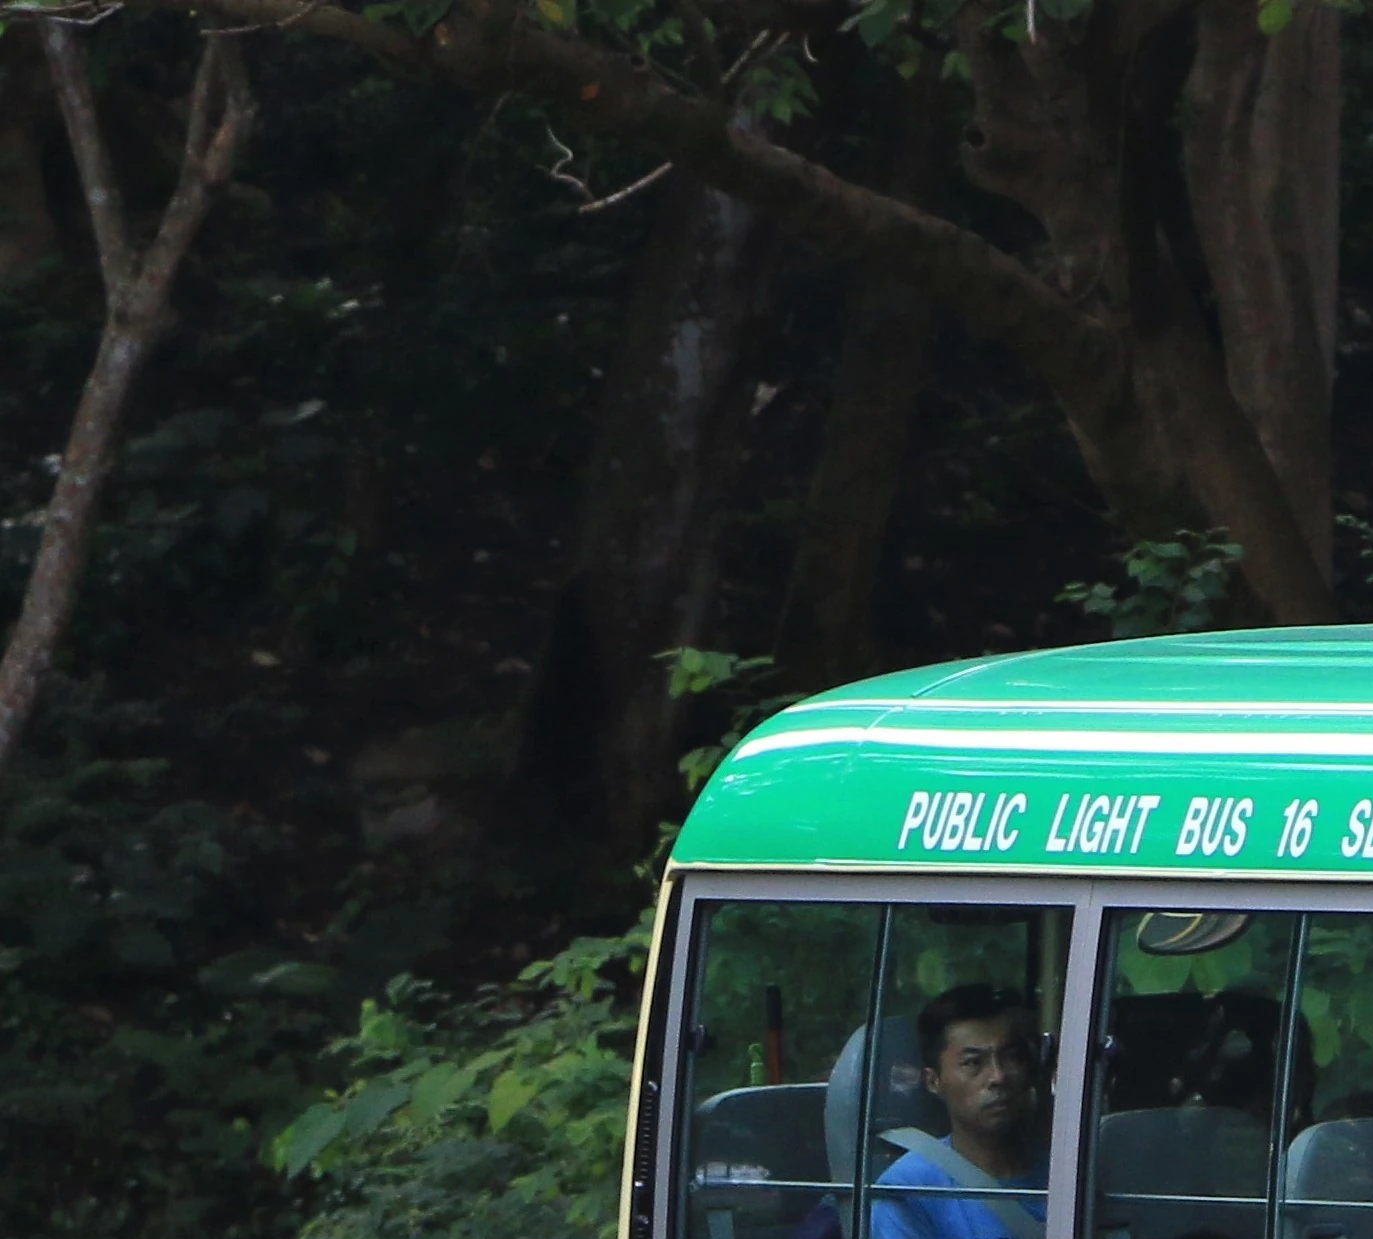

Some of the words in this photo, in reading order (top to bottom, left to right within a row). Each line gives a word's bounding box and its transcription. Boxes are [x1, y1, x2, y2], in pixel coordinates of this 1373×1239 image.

[897, 790, 1028, 852] PUBLIC
[1045, 792, 1161, 855] LIGHT
[1174, 796, 1255, 858] BUS
[1276, 797, 1320, 859] 16
